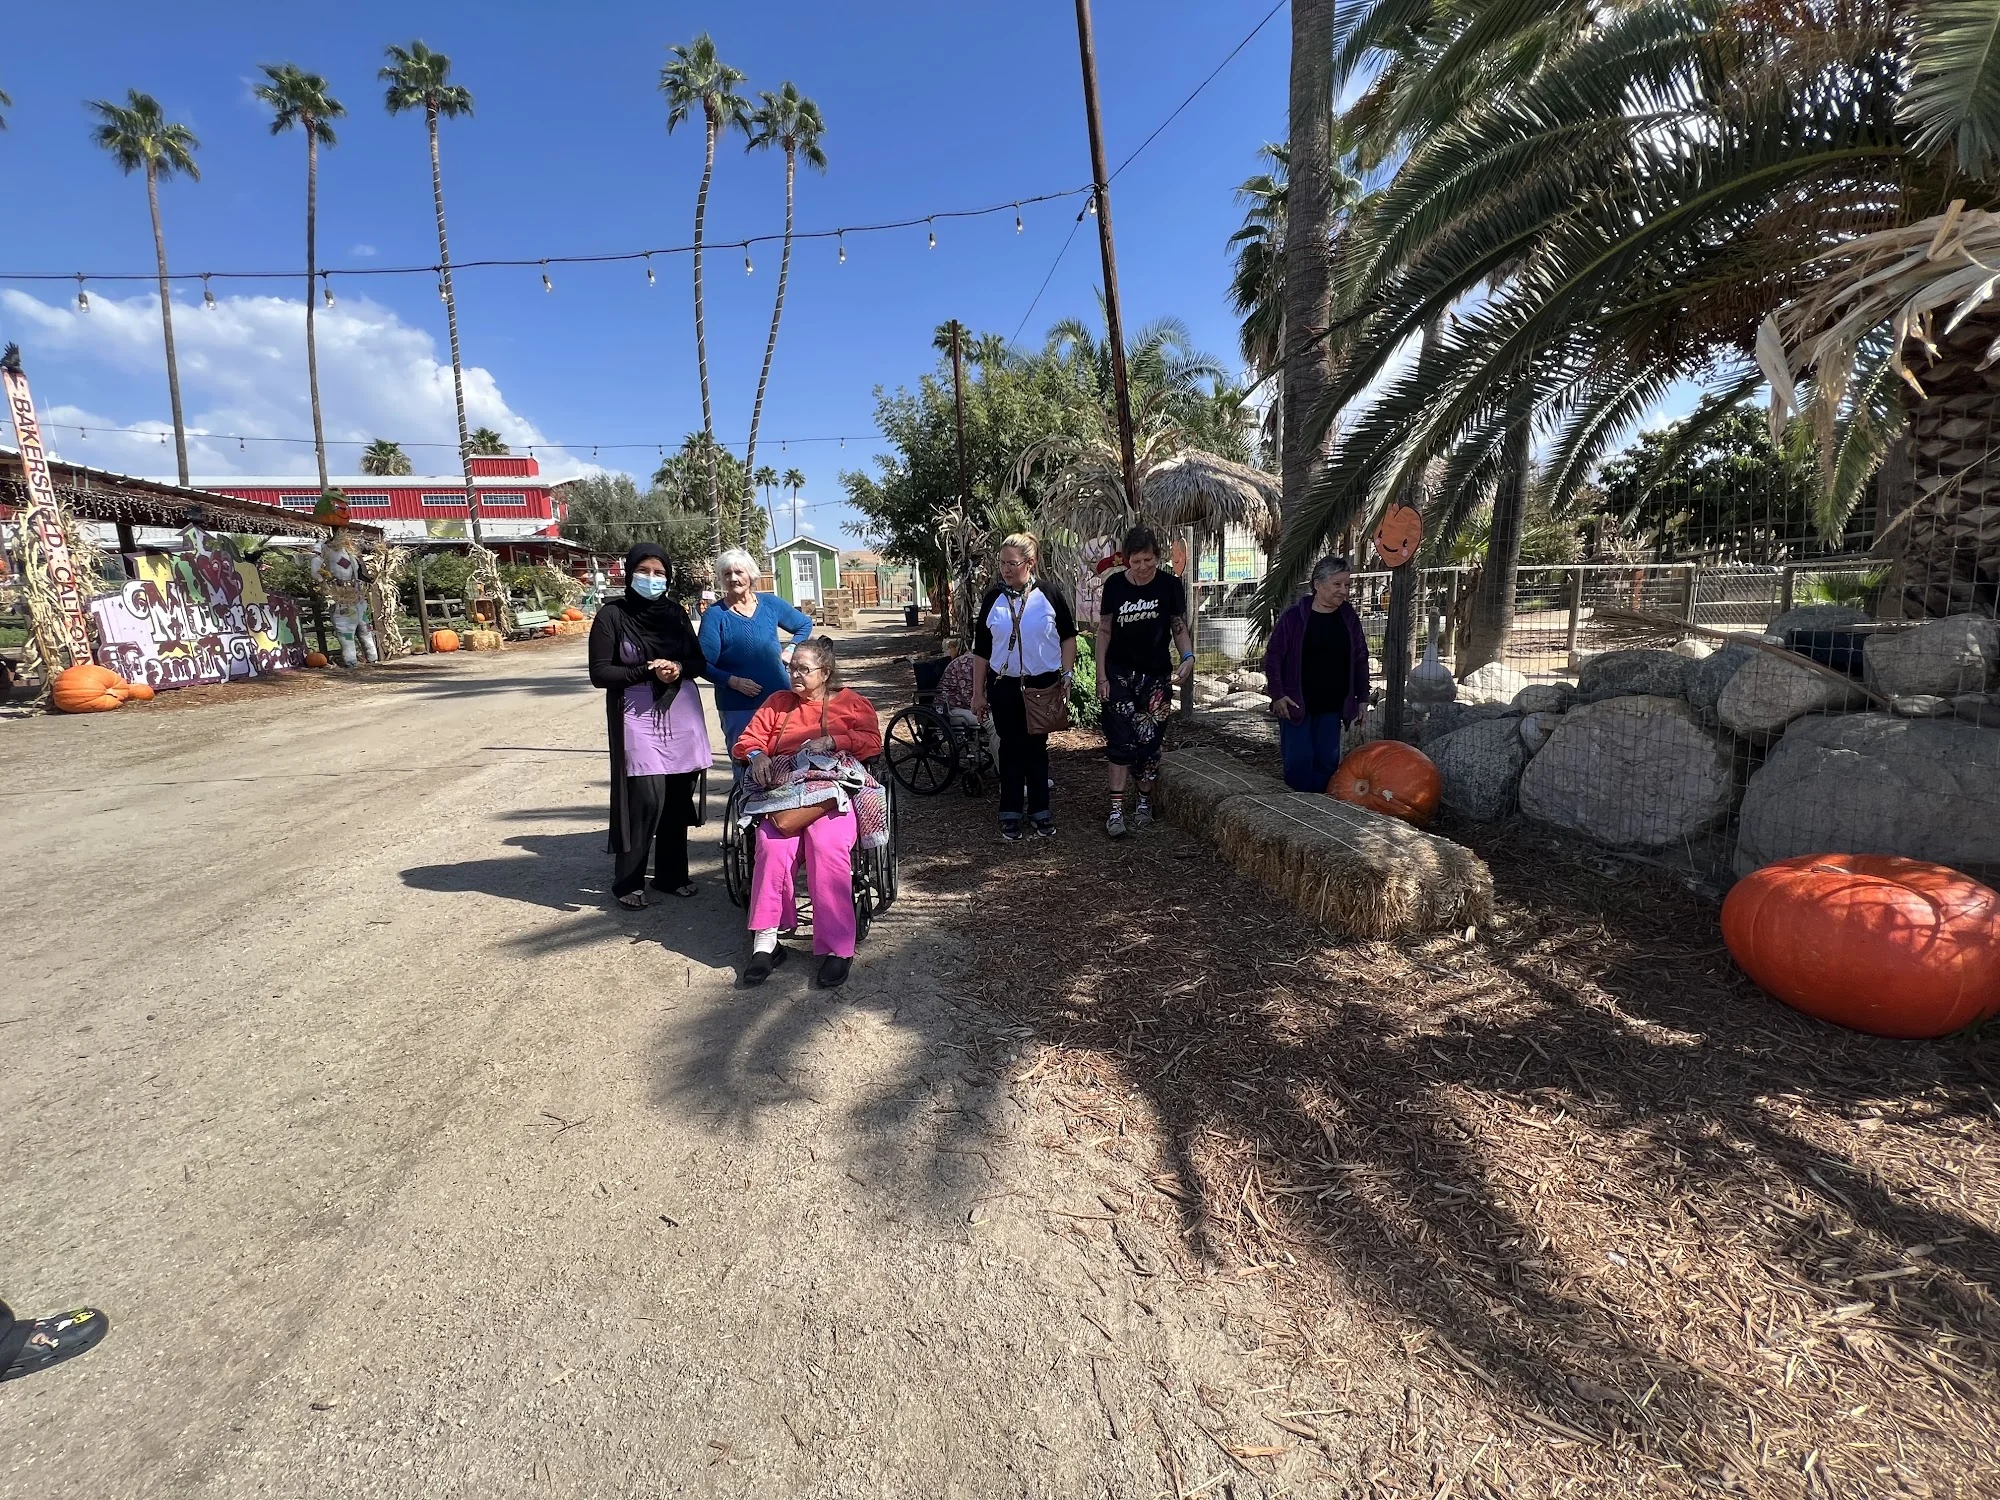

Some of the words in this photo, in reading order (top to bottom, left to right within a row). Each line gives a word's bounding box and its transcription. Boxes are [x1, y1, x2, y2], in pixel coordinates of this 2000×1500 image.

[1226, 566, 1252, 578] animals
[1118, 598, 1159, 615] status:
[55, 566, 93, 667] CALIFORN
[1116, 610, 1160, 628] queen
[97, 641, 231, 684] Family
